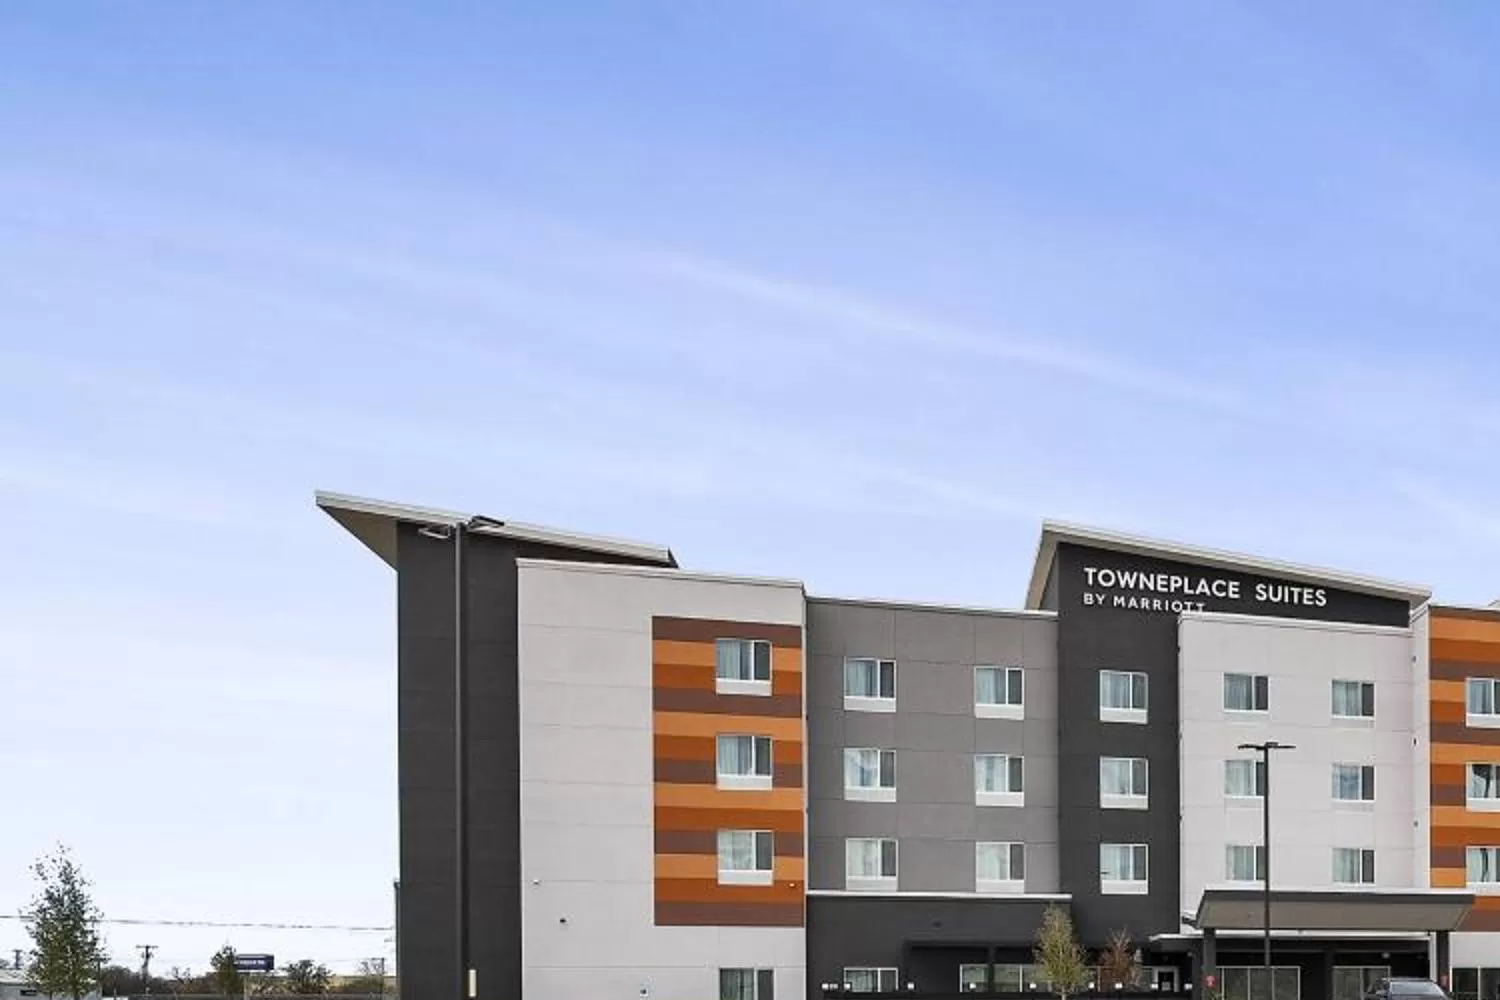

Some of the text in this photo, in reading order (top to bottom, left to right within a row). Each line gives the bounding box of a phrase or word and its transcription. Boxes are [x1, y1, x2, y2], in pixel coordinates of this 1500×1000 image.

[1083, 567, 1328, 607] TOWNEPLACE SUITES
[1083, 592, 1205, 612] BY MARRIOTT
